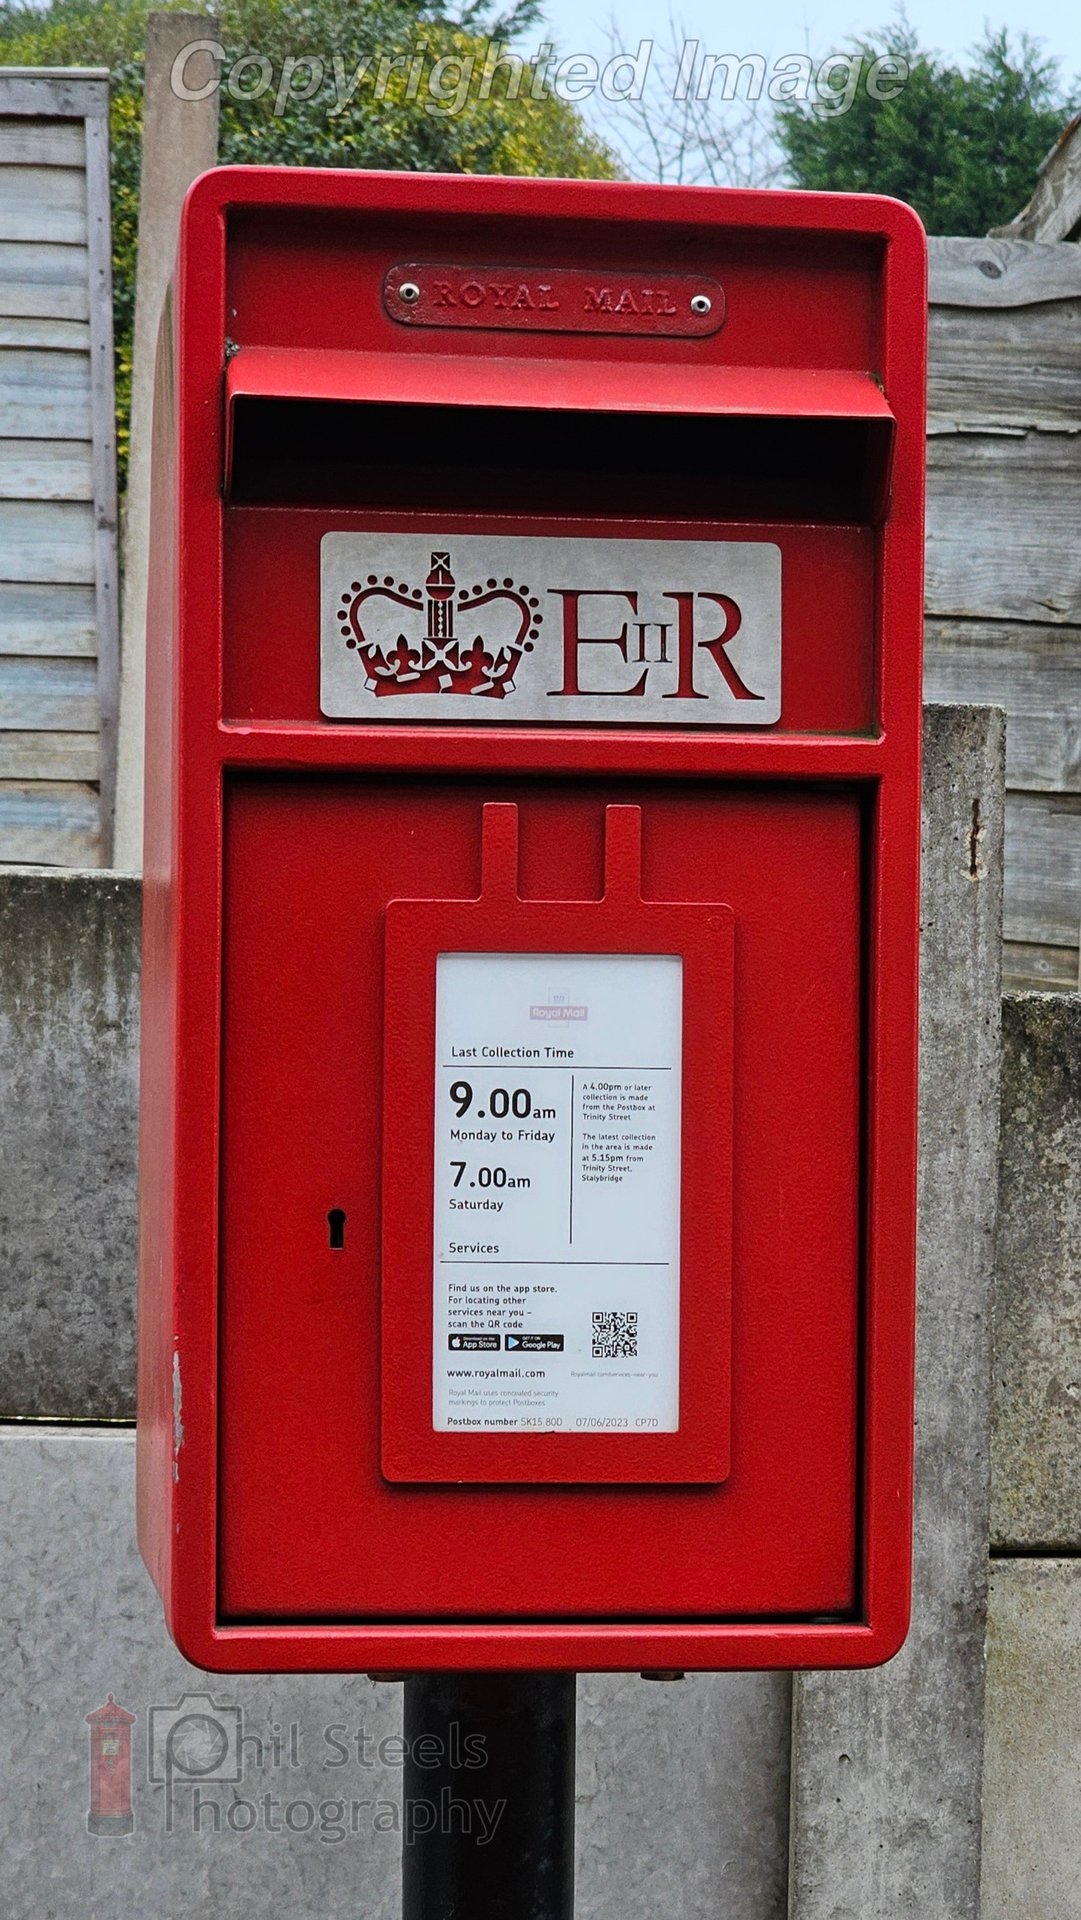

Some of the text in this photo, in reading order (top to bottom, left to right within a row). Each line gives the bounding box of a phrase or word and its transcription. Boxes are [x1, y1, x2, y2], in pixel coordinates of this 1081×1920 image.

[433, 280, 677, 316] ROYAL MAIL
[532, 1007, 585, 1019] Royal Mail
[452, 1046, 574, 1059] Last Collection Time
[590, 1082, 622, 1092] 4.00pm
[449, 1080, 556, 1119] 9.00am
[582, 1103, 600, 1111] from
[583, 1113, 631, 1122] Trinity Street
[450, 1129, 555, 1143] Monday to Friday
[598, 1133, 619, 1141] latest
[621, 1133, 656, 1141] collection
[624, 1143, 630, 1151] is
[633, 1143, 653, 1151] made
[592, 1153, 623, 1163] 5.15pm
[626, 1154, 644, 1162] from
[582, 1164, 606, 1173] Trinity
[449, 1160, 531, 1188] 7.00am
[581, 1174, 623, 1183] Stalybridge
[449, 1199, 504, 1212] Saturday
[449, 1242, 499, 1254] Services
[448, 1284, 467, 1293] Find
[470, 1285, 480, 1293] us
[496, 1284, 511, 1293] the
[513, 1286, 530, 1296] app
[532, 1285, 558, 1293] store.
[448, 1296, 526, 1307] For locating other
[448, 1308, 484, 1317] services
[486, 1309, 506, 1317] near
[508, 1309, 524, 1318] you
[448, 1320, 523, 1330] scan the QR code
[463, 1341, 498, 1349] App Store
[522, 1341, 561, 1350] Google Play
[447, 1368, 546, 1380] www.royalmail.com
[448, 1388, 467, 1397] Royal
[468, 1388, 482, 1397] Mail
[500, 1389, 532, 1397] concealed
[533, 1389, 559, 1398] security
[448, 1398, 479, 1407] markings
[489, 1399, 511, 1407] protect
[447, 1417, 481, 1426] Postbox
[484, 1417, 518, 1426] number
[520, 1417, 543, 1427] SK15
[576, 1417, 628, 1427] 07/06/2023
[635, 1418, 659, 1427] CP7D
